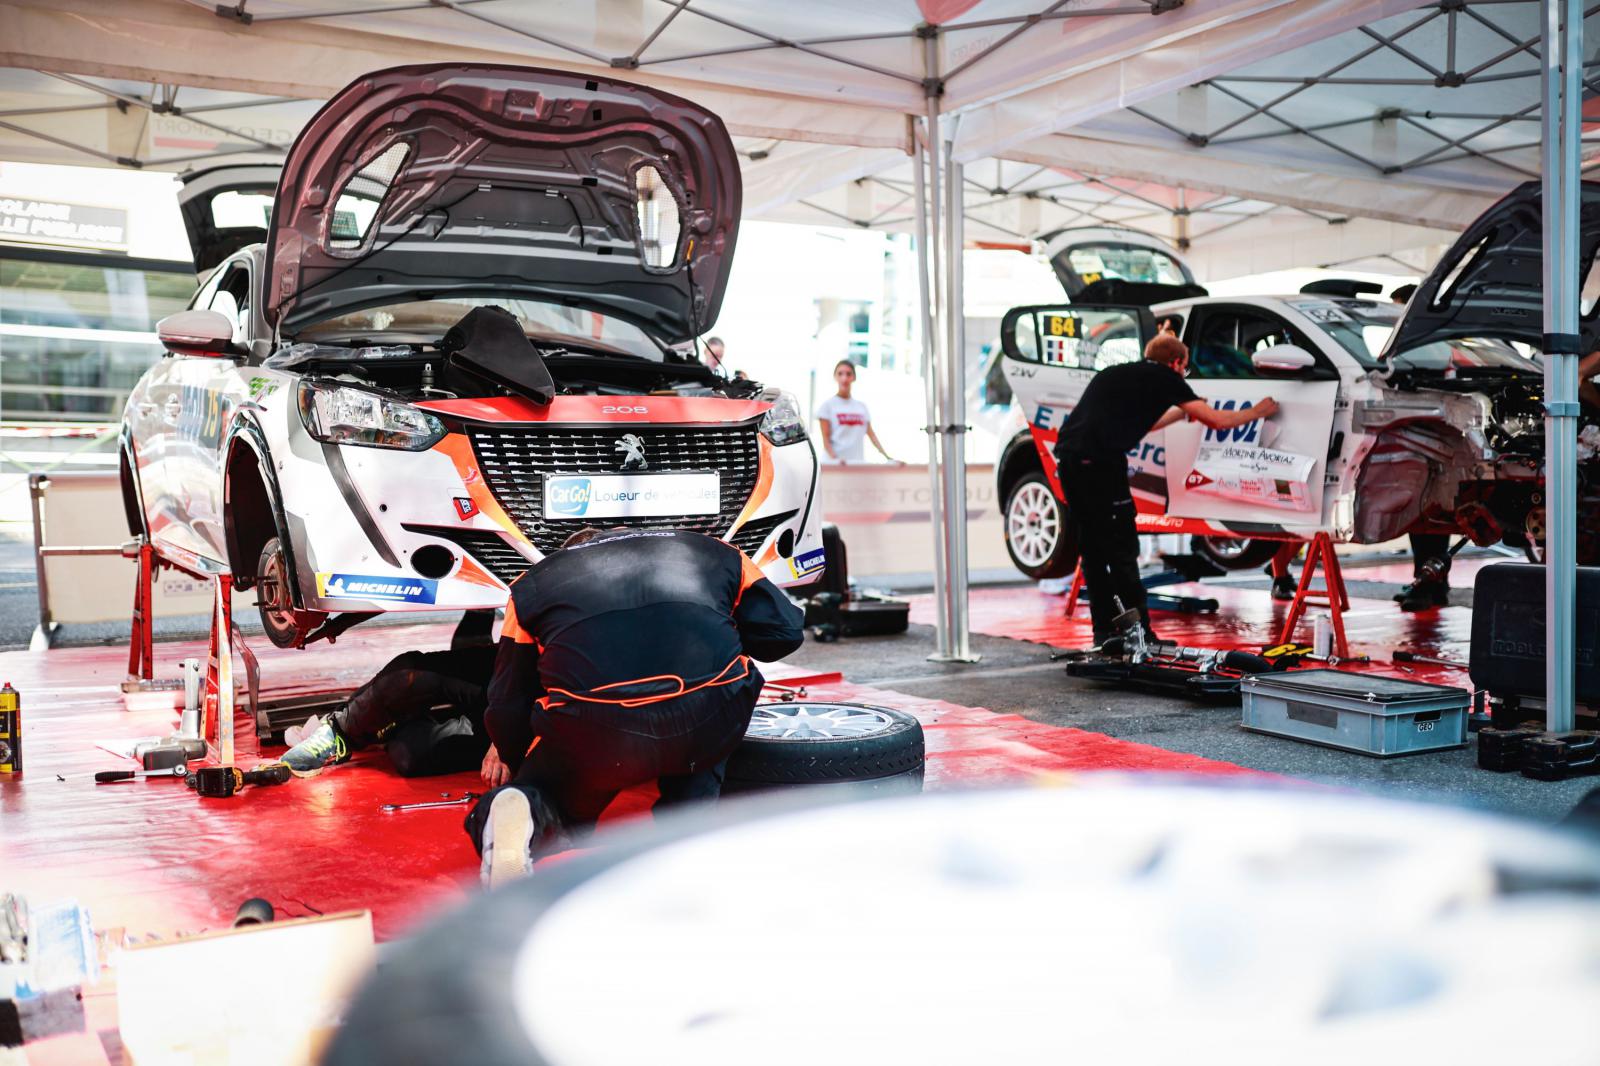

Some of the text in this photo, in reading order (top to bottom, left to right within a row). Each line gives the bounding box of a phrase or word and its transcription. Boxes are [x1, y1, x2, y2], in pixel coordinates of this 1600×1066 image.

[1051, 316, 1076, 337] 64
[602, 406, 649, 414] 208
[595, 490, 640, 502] Loueur
[644, 489, 660, 501] de
[346, 582, 423, 596] MICHELIN
[1418, 721, 1433, 732] GEO
